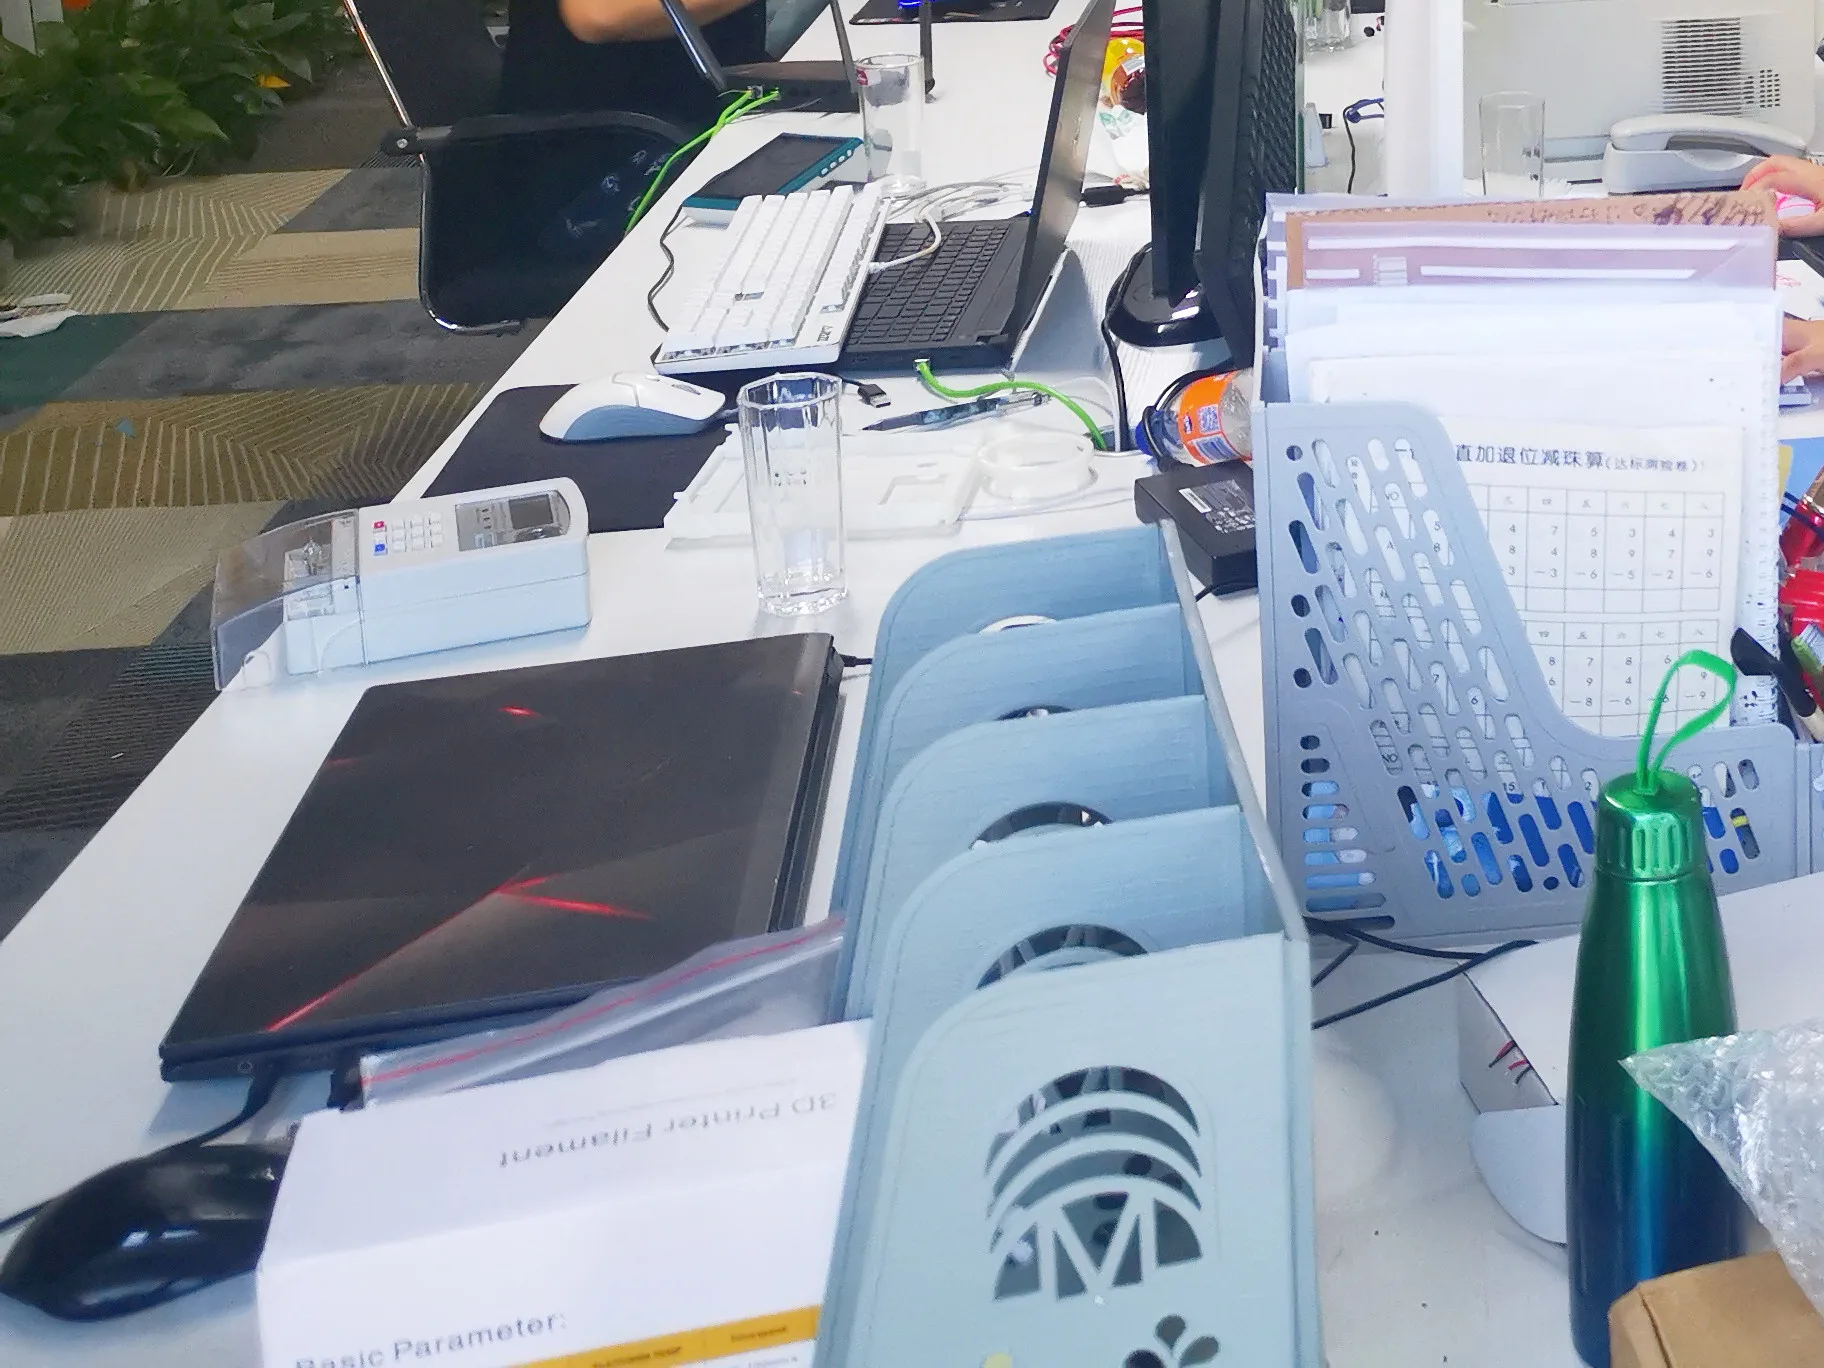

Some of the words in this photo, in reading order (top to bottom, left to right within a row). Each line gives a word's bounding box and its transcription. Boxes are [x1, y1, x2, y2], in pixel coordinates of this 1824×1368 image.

[663, 1100, 781, 1133] Printer
[791, 1092, 837, 1116] 3D
[499, 1122, 652, 1168] Filament
